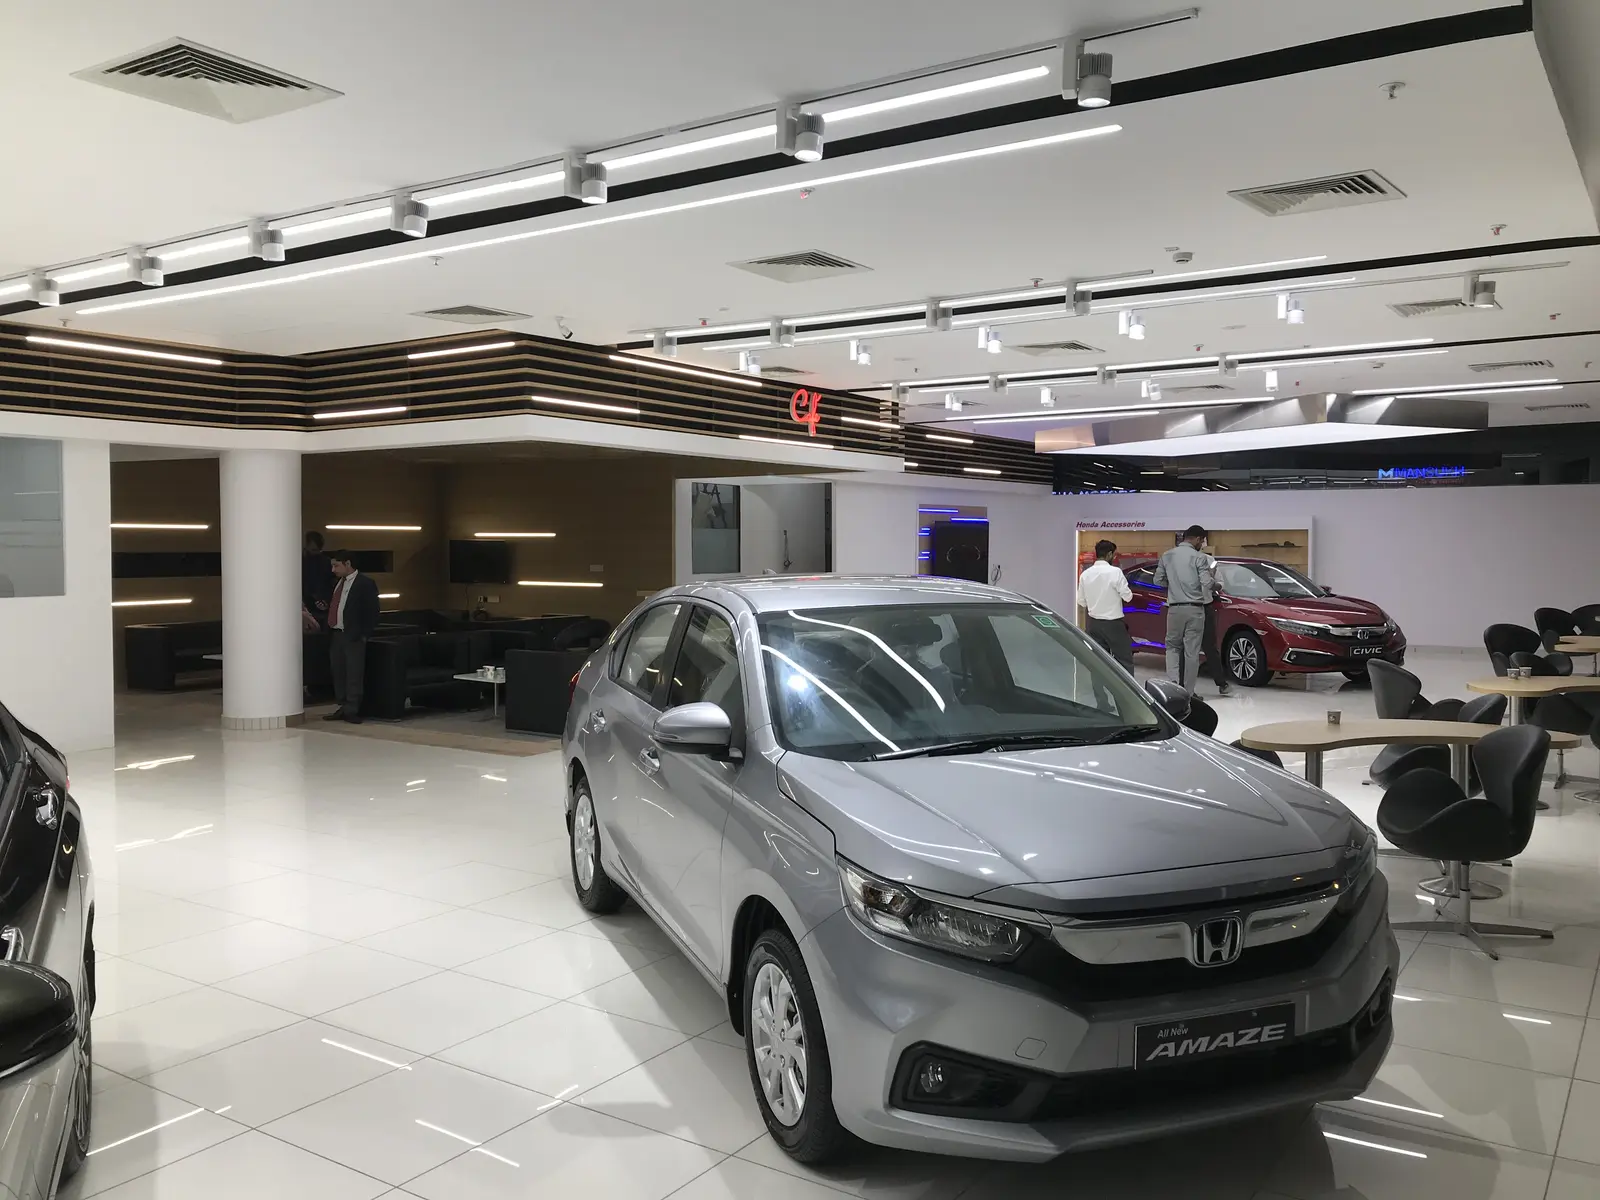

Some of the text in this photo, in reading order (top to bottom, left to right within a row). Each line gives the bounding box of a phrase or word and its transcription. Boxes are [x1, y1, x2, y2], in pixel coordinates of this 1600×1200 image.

[1353, 647, 1382, 655] CIVIC
[1157, 1026, 1189, 1039] All New
[1145, 1023, 1287, 1062] AMAZE
